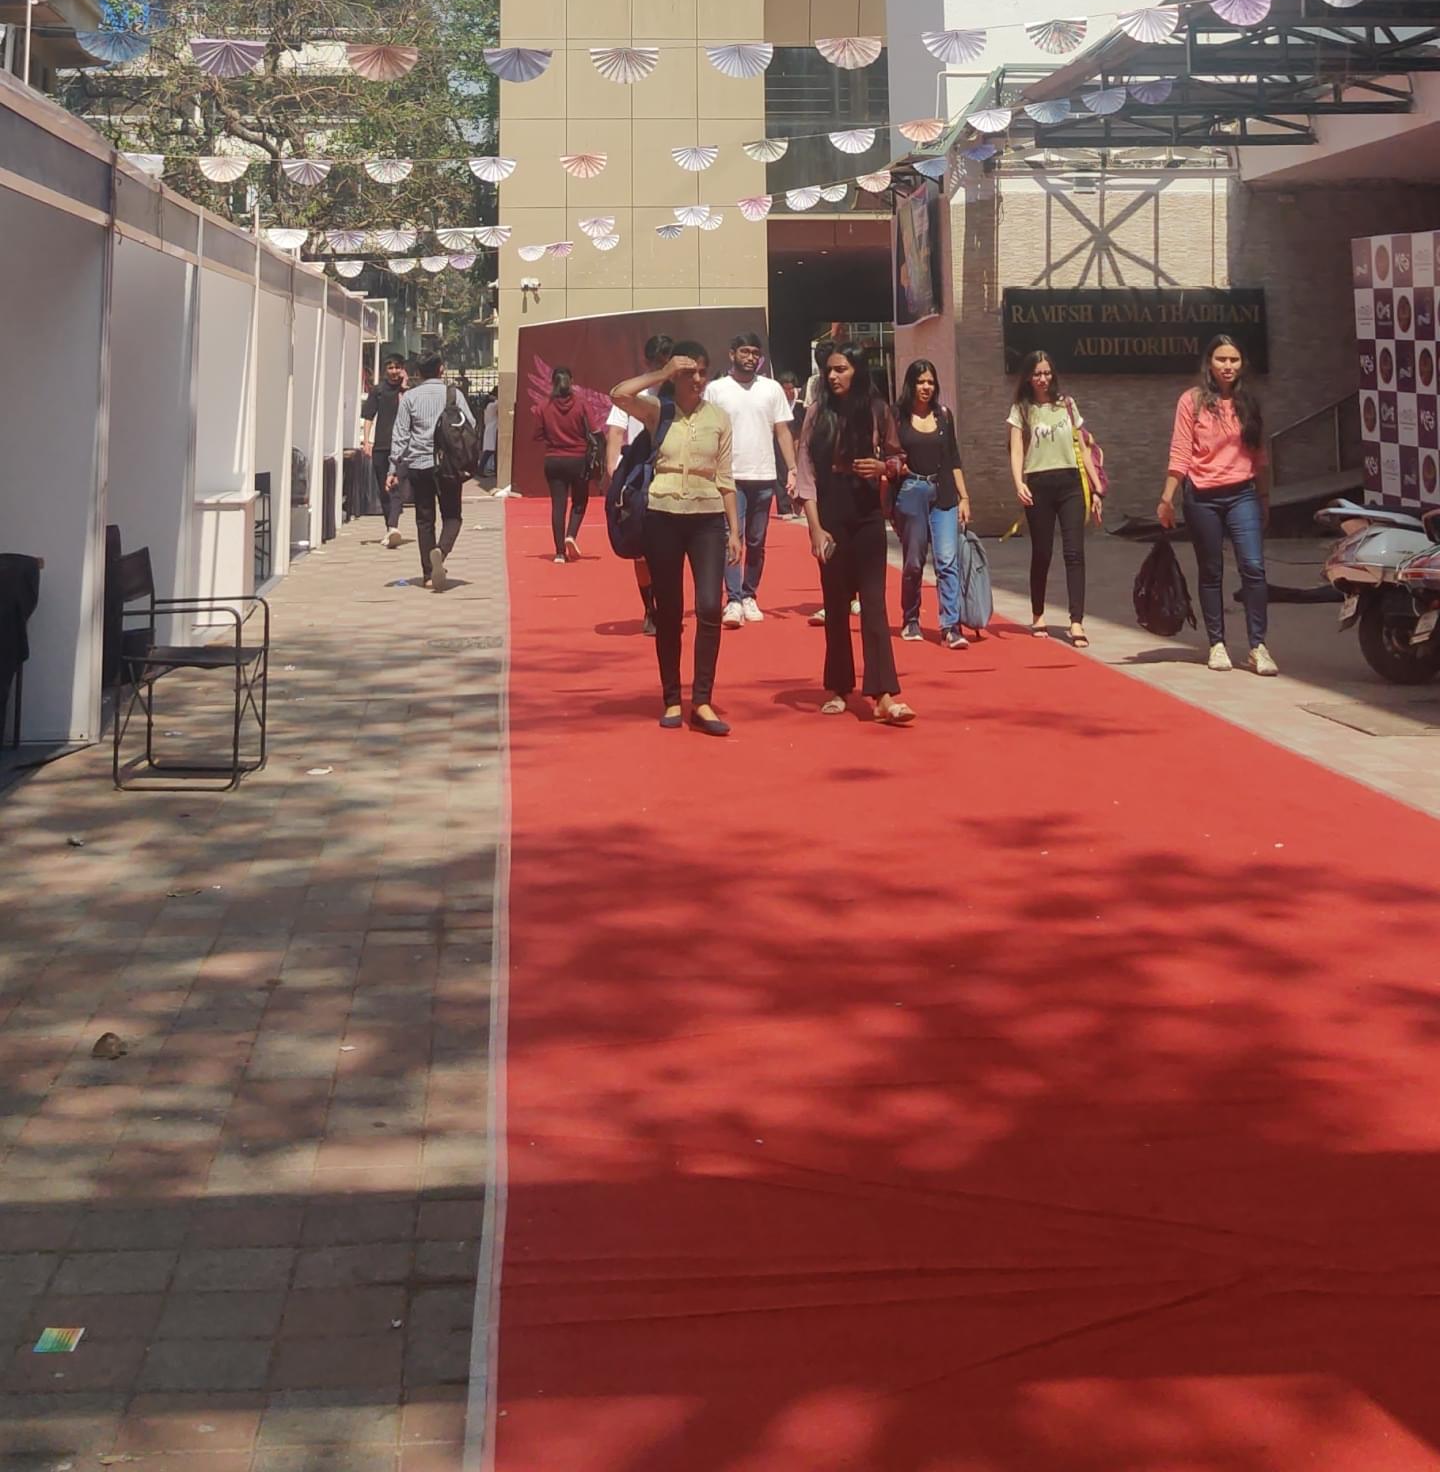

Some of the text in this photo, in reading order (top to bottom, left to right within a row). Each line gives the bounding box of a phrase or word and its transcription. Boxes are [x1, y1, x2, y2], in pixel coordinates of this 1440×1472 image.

[1011, 303, 1261, 324] RAMESH PAMA THADHANI
[1073, 336, 1199, 357] AUDITORIUM
